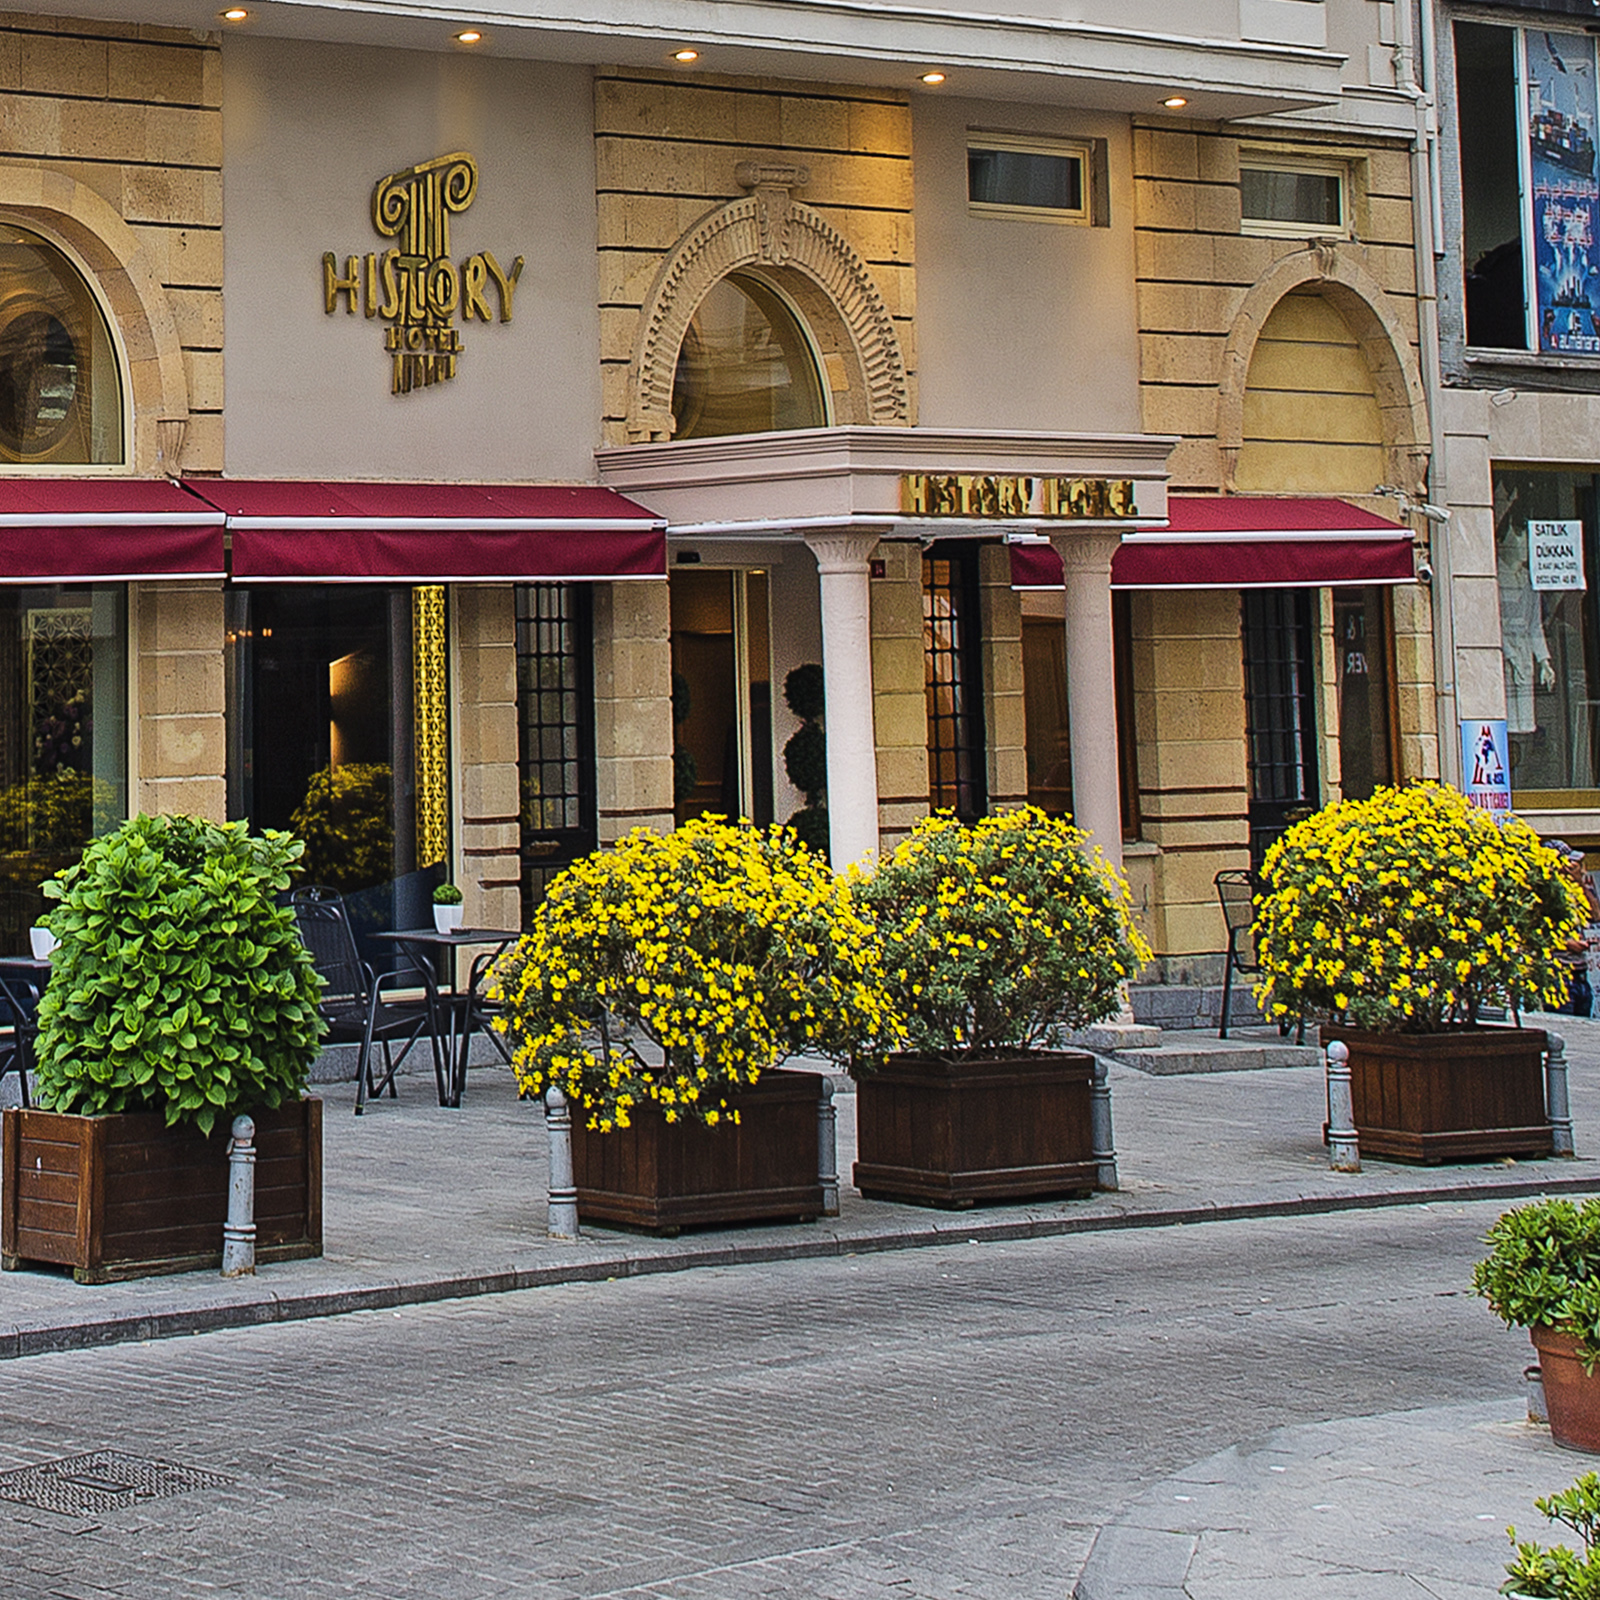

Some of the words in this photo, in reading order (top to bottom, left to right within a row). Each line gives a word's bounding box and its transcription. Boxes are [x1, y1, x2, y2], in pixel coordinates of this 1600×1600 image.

[322, 247, 525, 323] HISTORY
[383, 325, 466, 354] HOTEL
[1536, 541, 1574, 558] DÜKKAN
